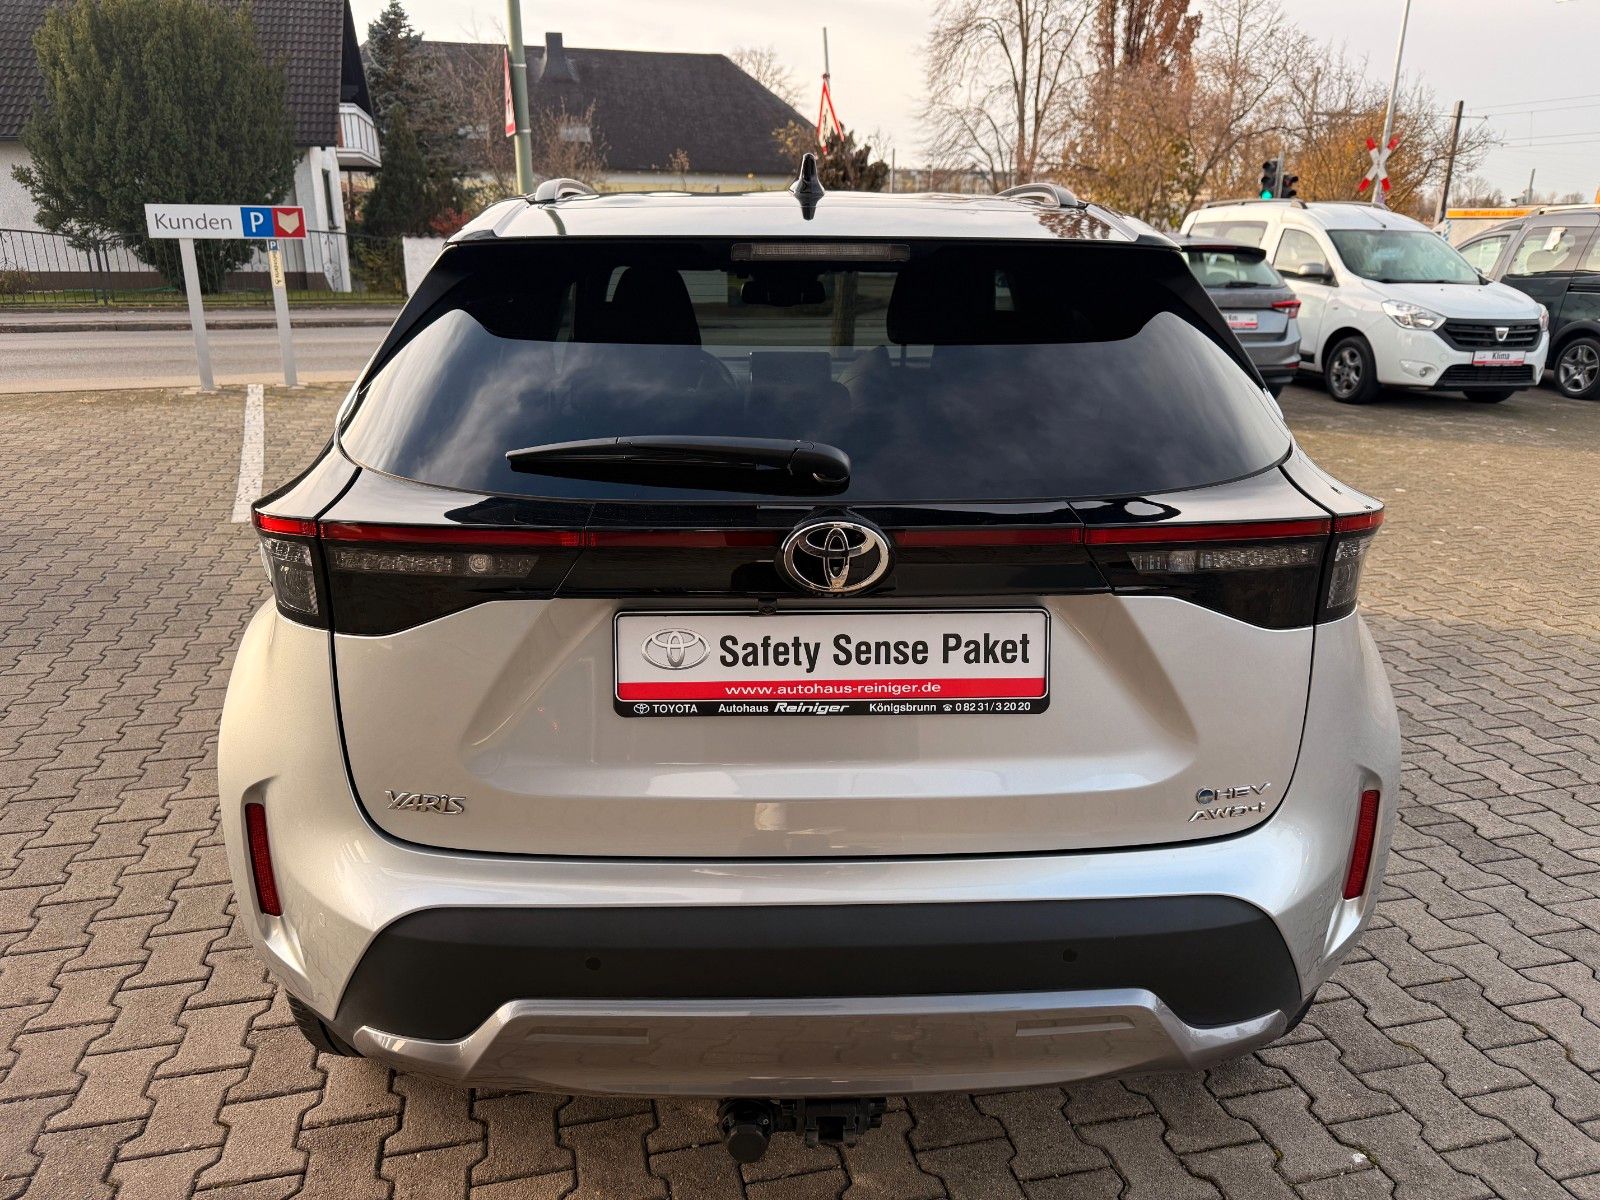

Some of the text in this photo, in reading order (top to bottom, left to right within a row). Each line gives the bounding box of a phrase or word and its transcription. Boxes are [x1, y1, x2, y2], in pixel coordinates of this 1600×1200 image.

[154, 211, 264, 233] Kunden P
[1491, 352, 1511, 360] Klima
[719, 632, 1030, 673] Safety Sense Paket
[724, 680, 942, 697] www.autohaus-reiniger.de
[652, 703, 698, 714] TOYOTA
[718, 703, 769, 713] Autohaus
[773, 702, 850, 715] Reiniger
[869, 702, 937, 714] Königsbrunn
[1214, 782, 1271, 800] HEV
